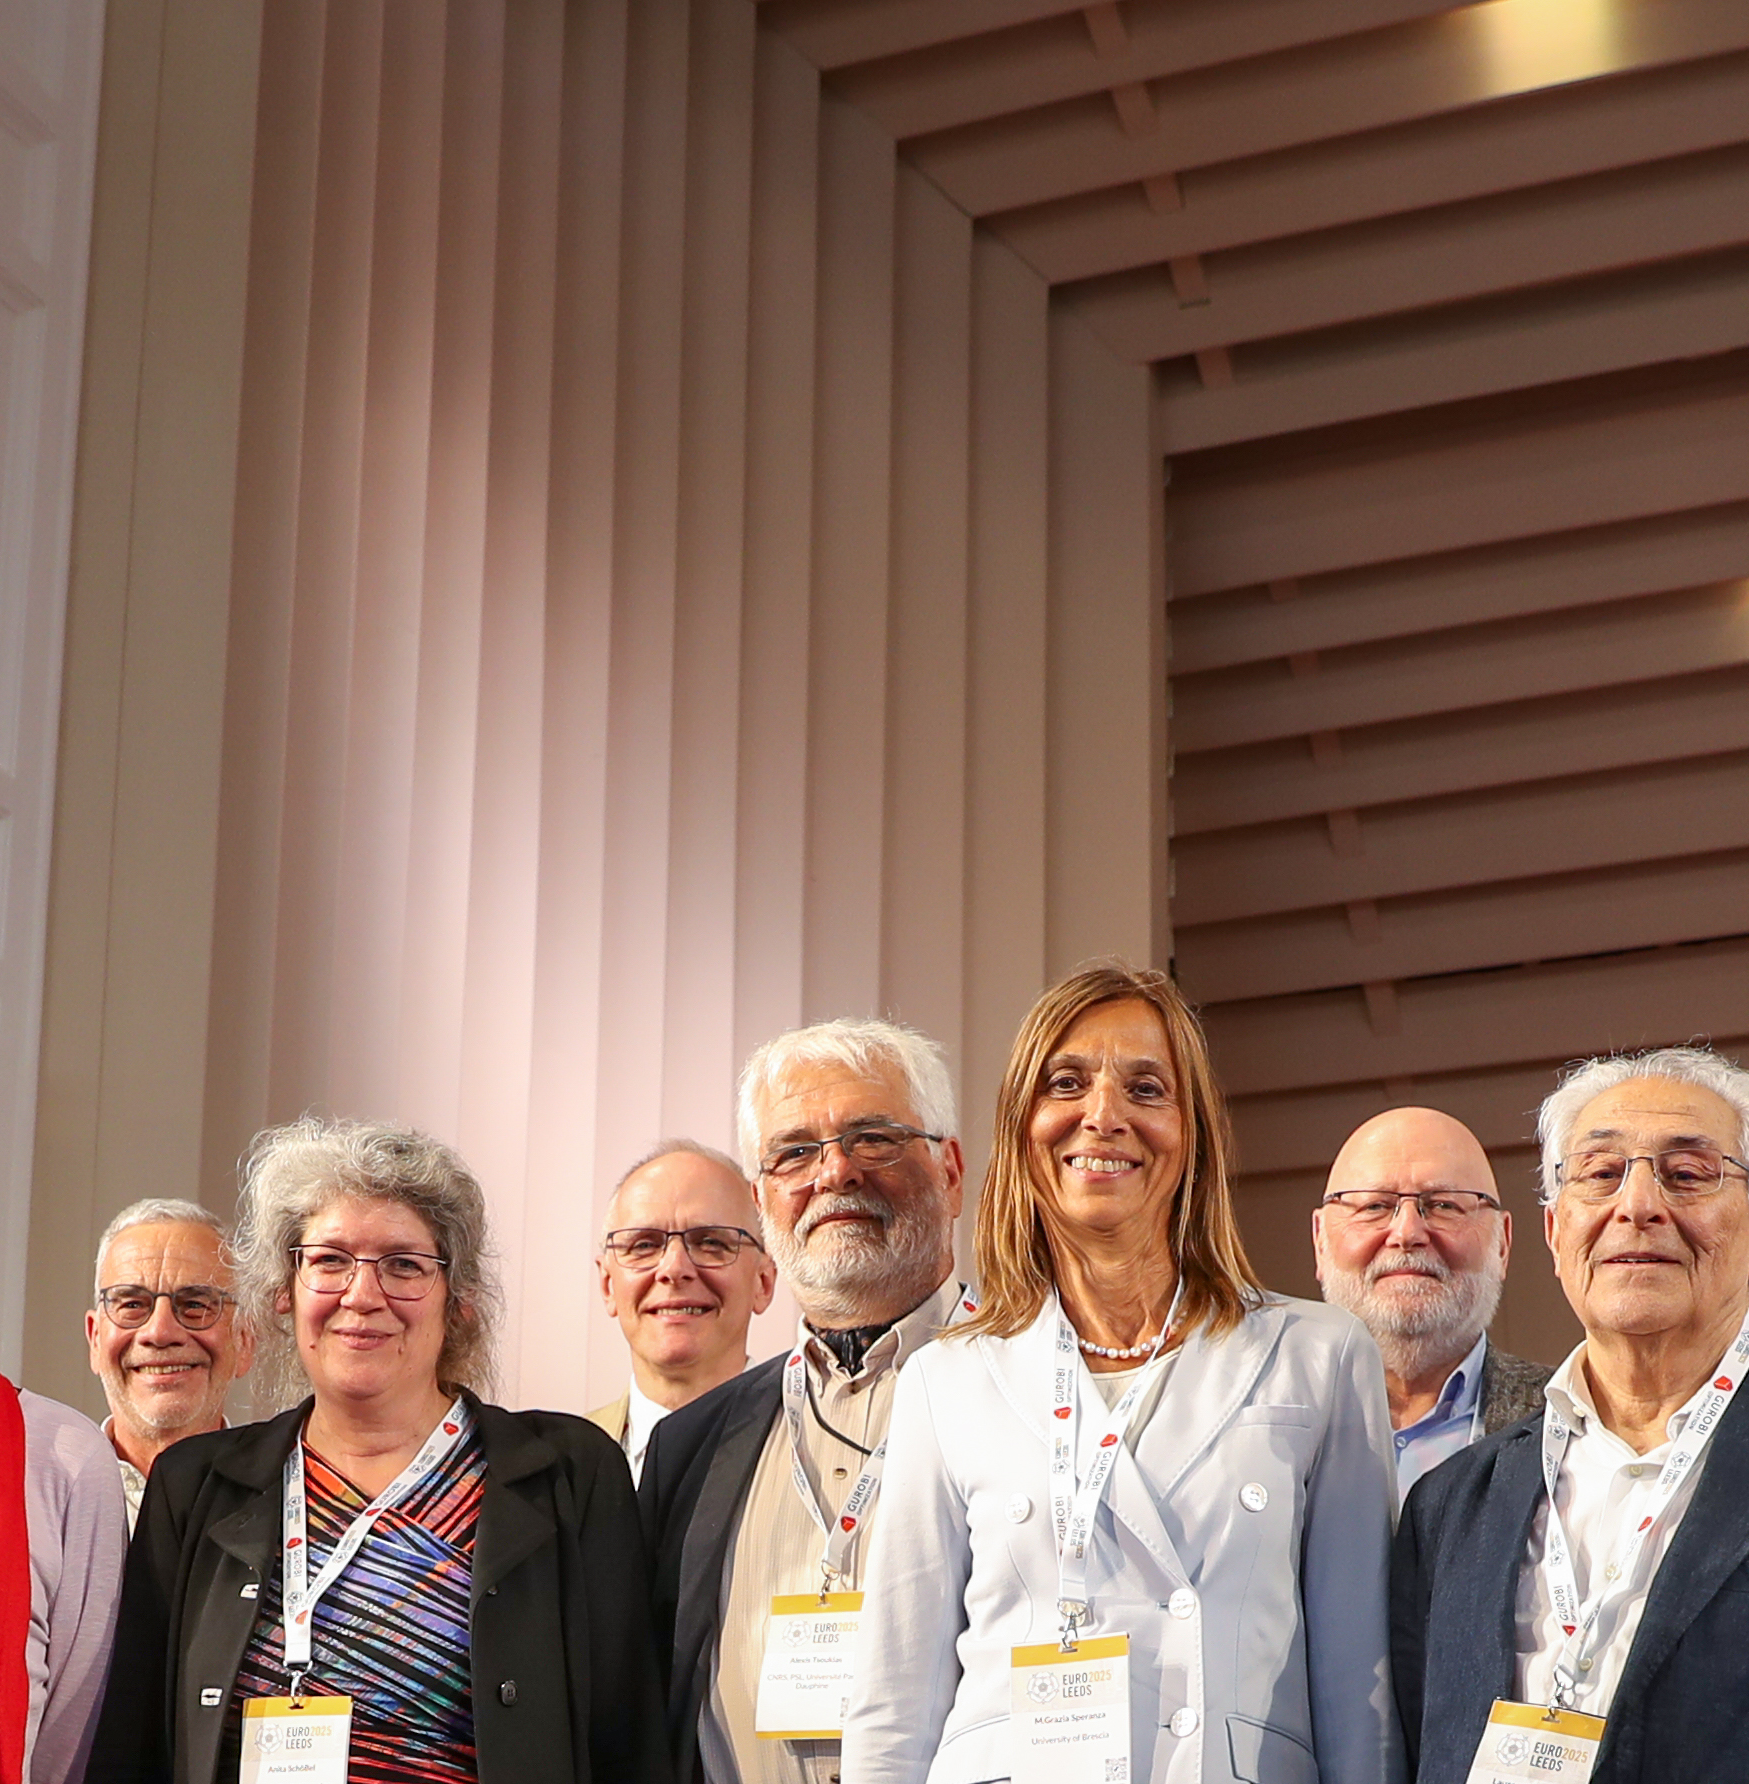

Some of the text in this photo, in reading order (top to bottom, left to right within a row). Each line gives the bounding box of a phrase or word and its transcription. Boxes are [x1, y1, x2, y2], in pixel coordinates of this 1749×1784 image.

[1055, 1368, 1066, 1403] GUROBI
[1696, 1395, 1725, 1435] GUROBI
[1091, 1451, 1112, 1491] GUROBI
[847, 1474, 871, 1511] GUROBI
[1056, 1496, 1067, 1541] GUROBI
[1553, 1585, 1568, 1621] GUROBI
[812, 1633, 840, 1644] LEEDS
[1062, 1669, 1112, 1686] EURO2025
[1062, 1685, 1092, 1698] LEEDS
[286, 1725, 332, 1737] EURO2025
[285, 1738, 313, 1749] LEEDS
[1533, 1742, 1589, 1764] EURO2025
[1529, 1754, 1564, 1772] LEEDS
